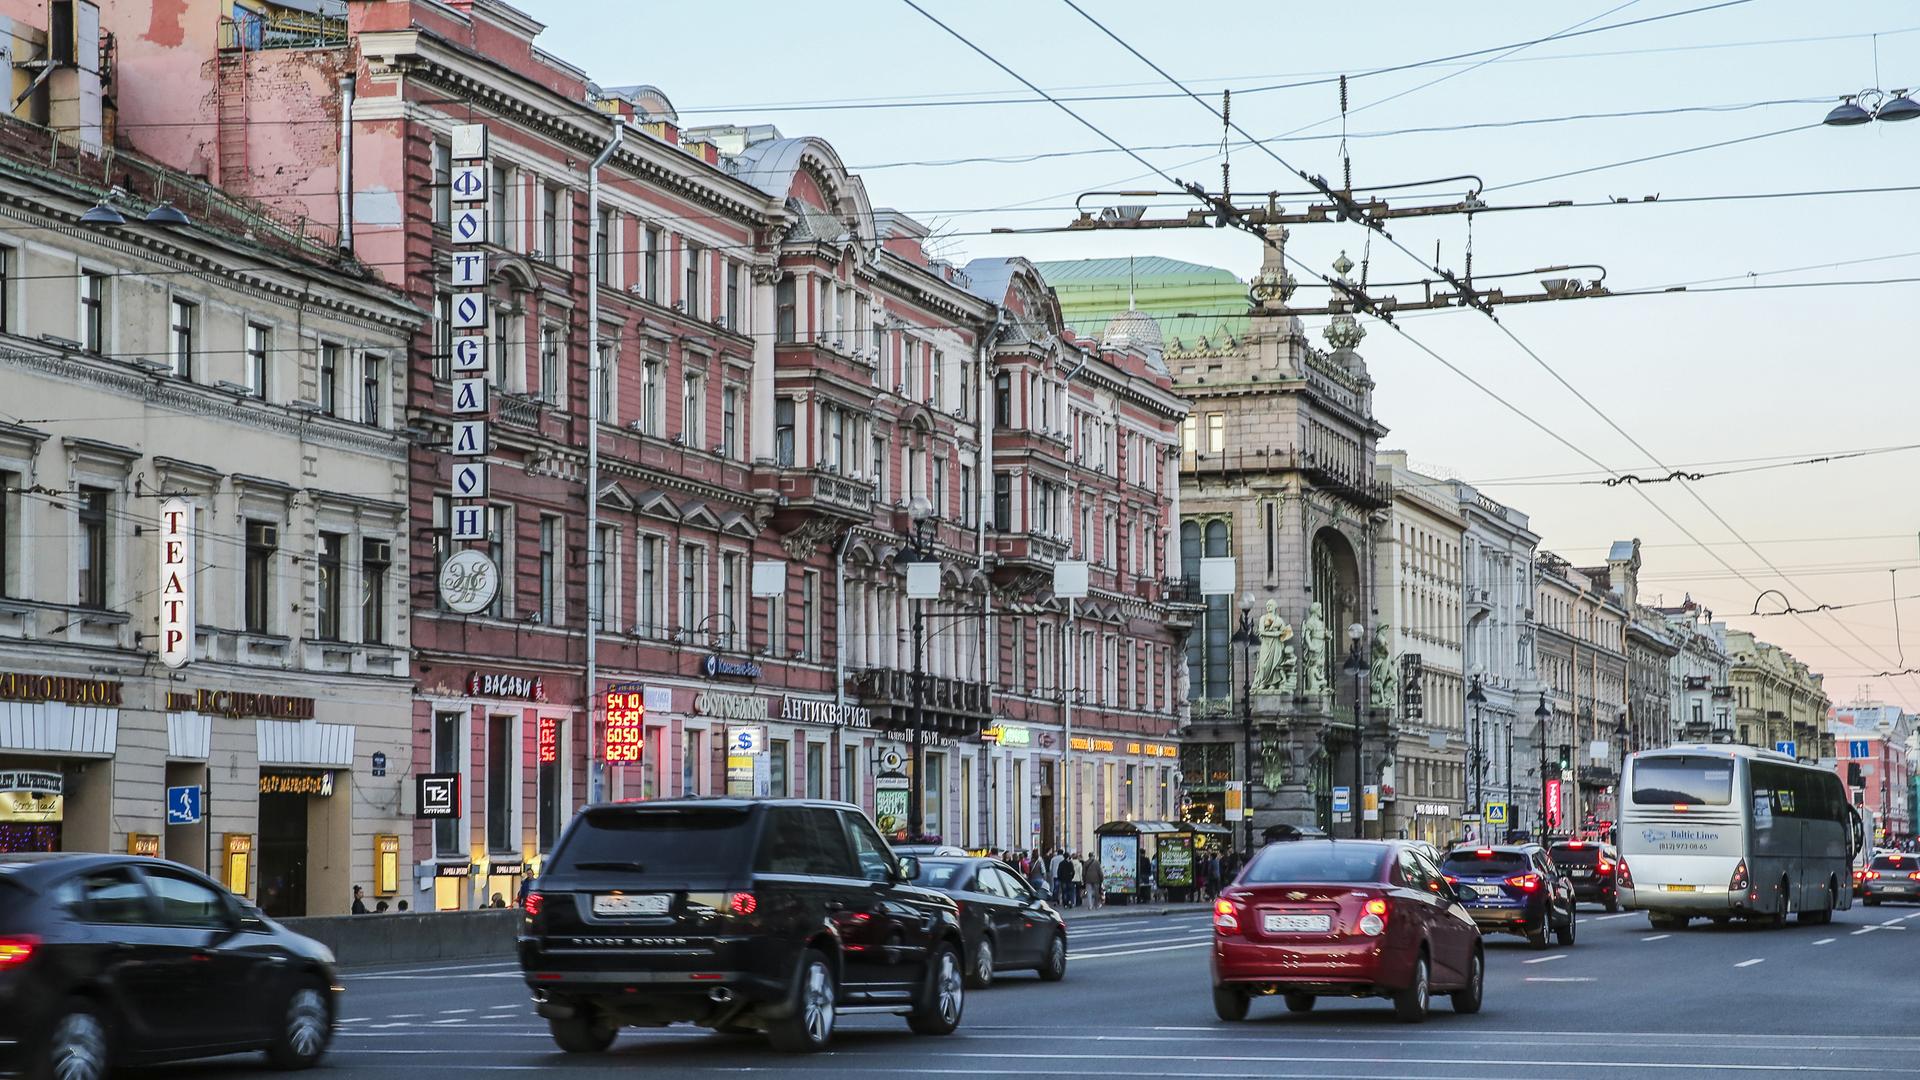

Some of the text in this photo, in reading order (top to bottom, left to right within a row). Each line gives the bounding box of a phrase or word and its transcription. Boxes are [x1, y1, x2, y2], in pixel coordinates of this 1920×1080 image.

[453, 170, 482, 536] ФОТОСАЛОН
[164, 511, 184, 653] ТЕАТР
[484, 674, 531, 698] ВАСАБИ
[1671, 830, 1719, 840] Baltic Lines
